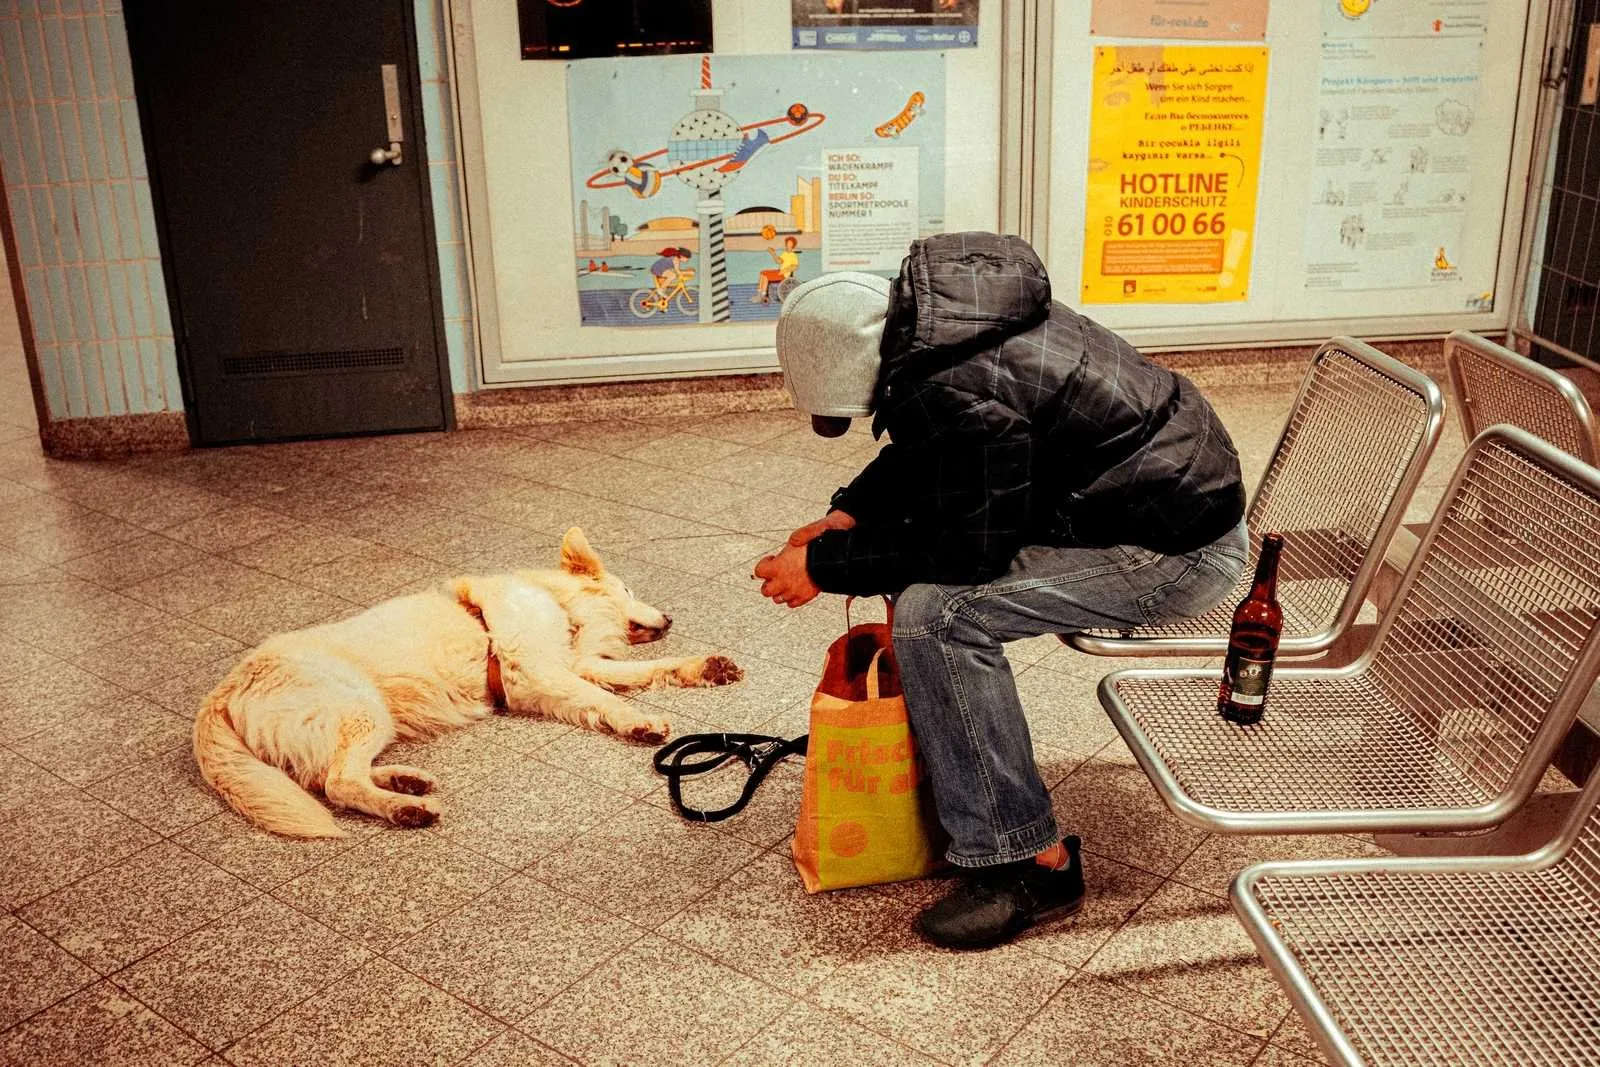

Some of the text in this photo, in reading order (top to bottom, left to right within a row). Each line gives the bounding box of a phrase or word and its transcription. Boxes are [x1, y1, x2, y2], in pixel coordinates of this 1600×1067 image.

[1172, 82, 1185, 91] Sie
[1204, 82, 1233, 93] Sorgen
[1191, 94, 1211, 103] Kind
[1138, 139, 1156, 148] Bir
[1207, 138, 1241, 150] ilgili
[828, 162, 893, 171] WADENKRAMPF
[828, 181, 879, 190] TITELKAMPF
[1120, 172, 1229, 195] HOTLINE
[828, 192, 858, 200] BERLIN
[828, 199, 909, 209] SPORTMETROPOLE
[1120, 195, 1228, 209] KINDERSCHUTZ
[828, 210, 867, 218] NUMMER
[1117, 211, 1226, 237] 61 00 66
[827, 766, 881, 794] für
